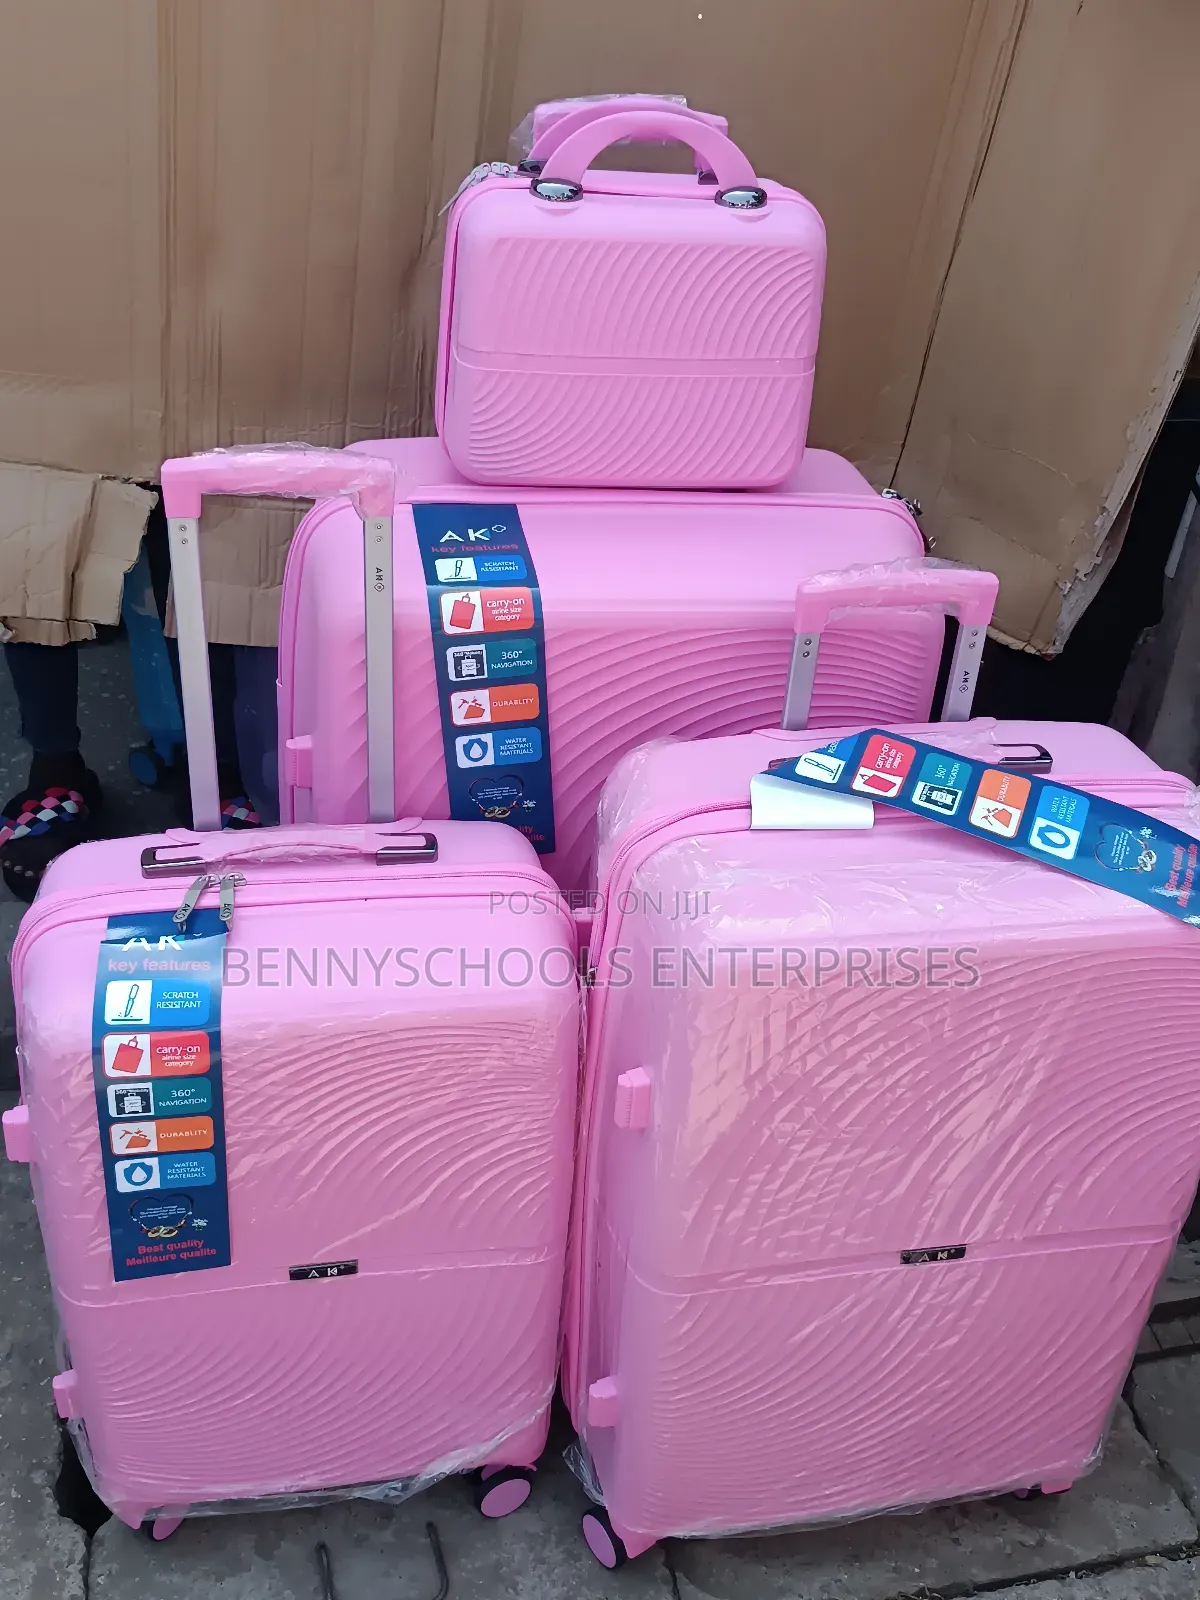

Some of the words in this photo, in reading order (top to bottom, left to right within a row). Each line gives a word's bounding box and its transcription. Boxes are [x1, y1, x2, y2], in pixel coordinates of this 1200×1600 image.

[461, 544, 519, 552] features
[486, 598, 525, 608] carry-on
[495, 614, 520, 622] category
[491, 660, 533, 669] NAVIGATION
[500, 748, 534, 756] MATERIALS
[1172, 844, 1186, 870] quality
[1165, 870, 1180, 891] Best
[108, 959, 138, 974] key
[143, 958, 211, 971] features
[162, 991, 199, 999] SCRATCH
[156, 1045, 201, 1055] carry-on
[165, 1060, 194, 1068] category
[171, 1088, 196, 1098] 360°
[159, 1098, 207, 1107] NAVIGATION
[167, 1172, 207, 1180] MATERIALS
[137, 1244, 164, 1254] Best
[167, 1239, 204, 1251] quality
[126, 1254, 177, 1267] Meilleure
